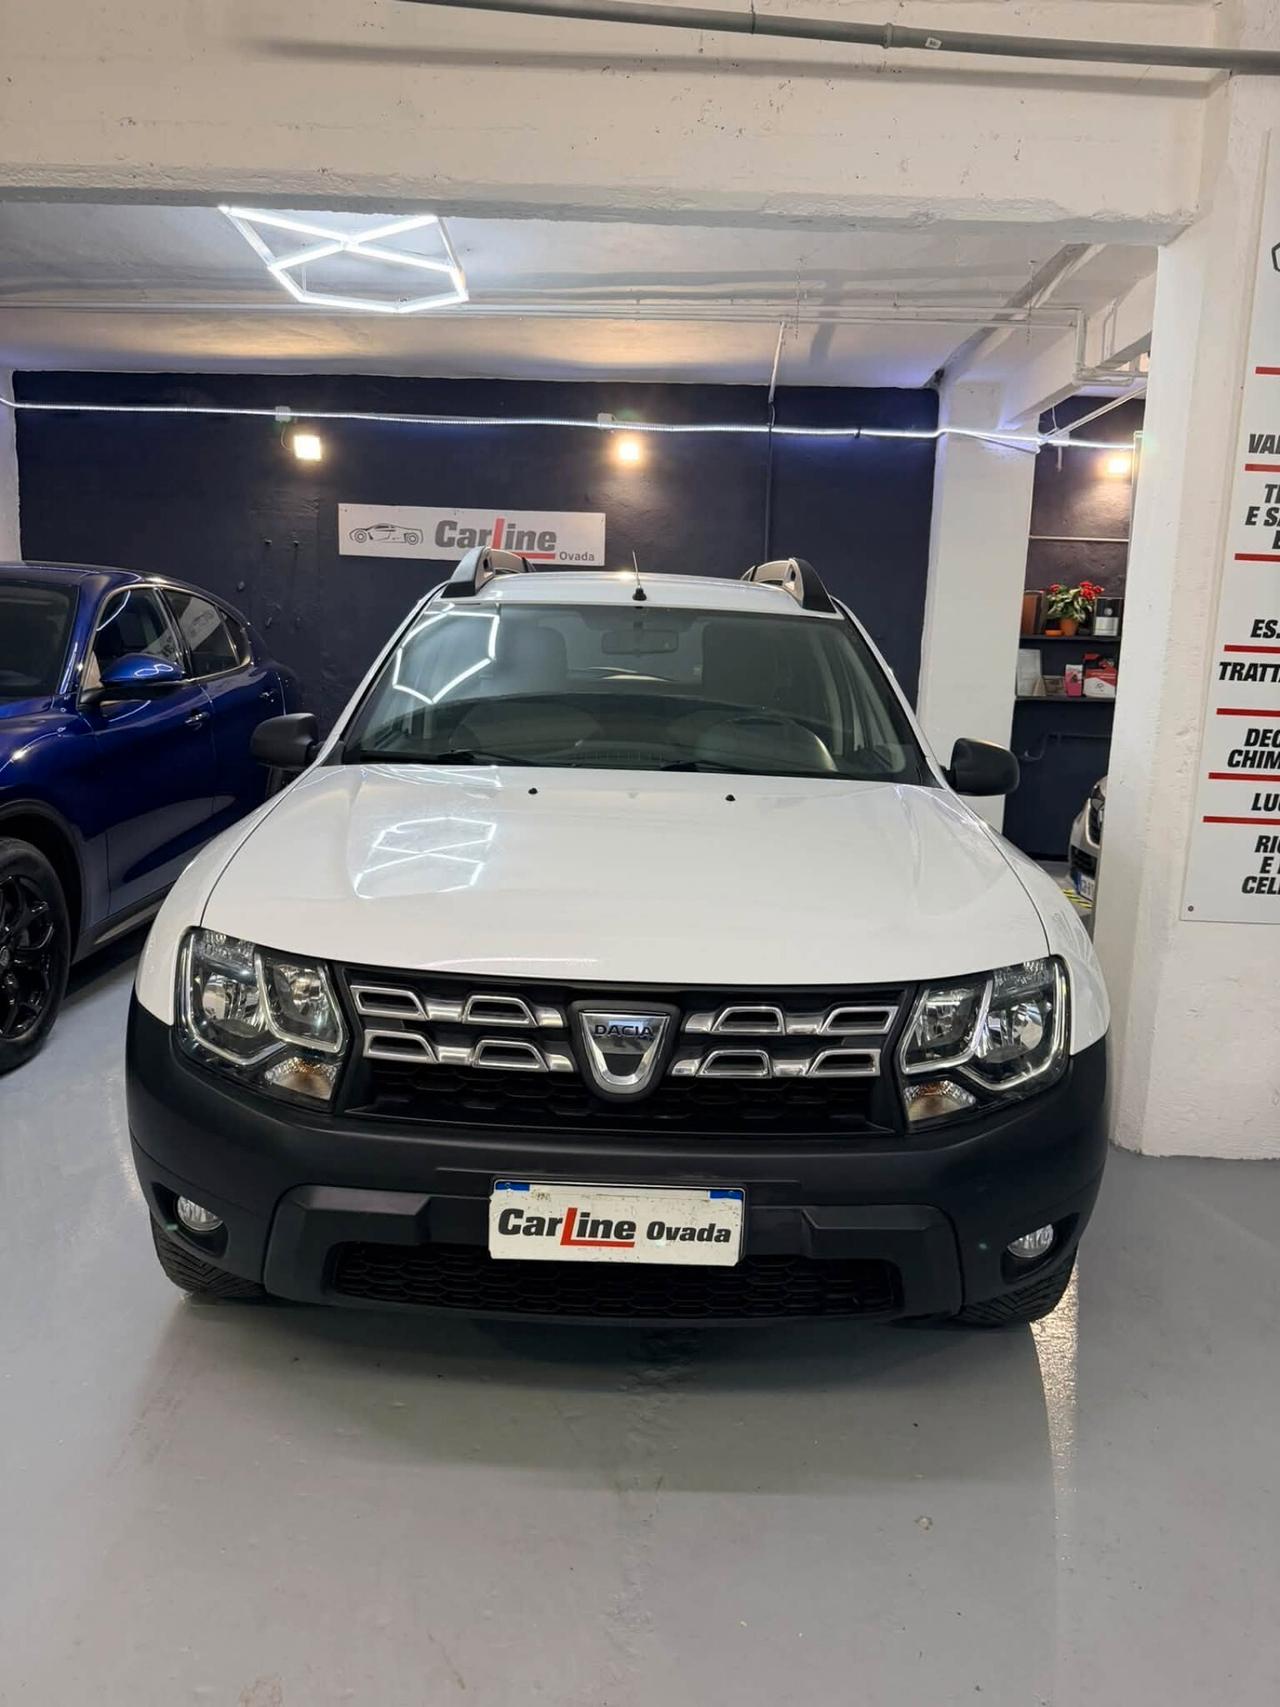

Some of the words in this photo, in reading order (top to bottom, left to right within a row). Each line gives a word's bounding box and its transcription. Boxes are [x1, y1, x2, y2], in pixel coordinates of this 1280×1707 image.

[1245, 505, 1260, 526] E
[1263, 507, 1280, 527] S
[559, 551, 595, 561] Ovada
[1219, 661, 1280, 683] TRATT
[1259, 856, 1274, 874] E
[1241, 875, 1280, 895] CEL
[594, 1024, 654, 1037] DACIA
[498, 1207, 637, 1249] CarLine
[646, 1220, 732, 1243] Ovada
